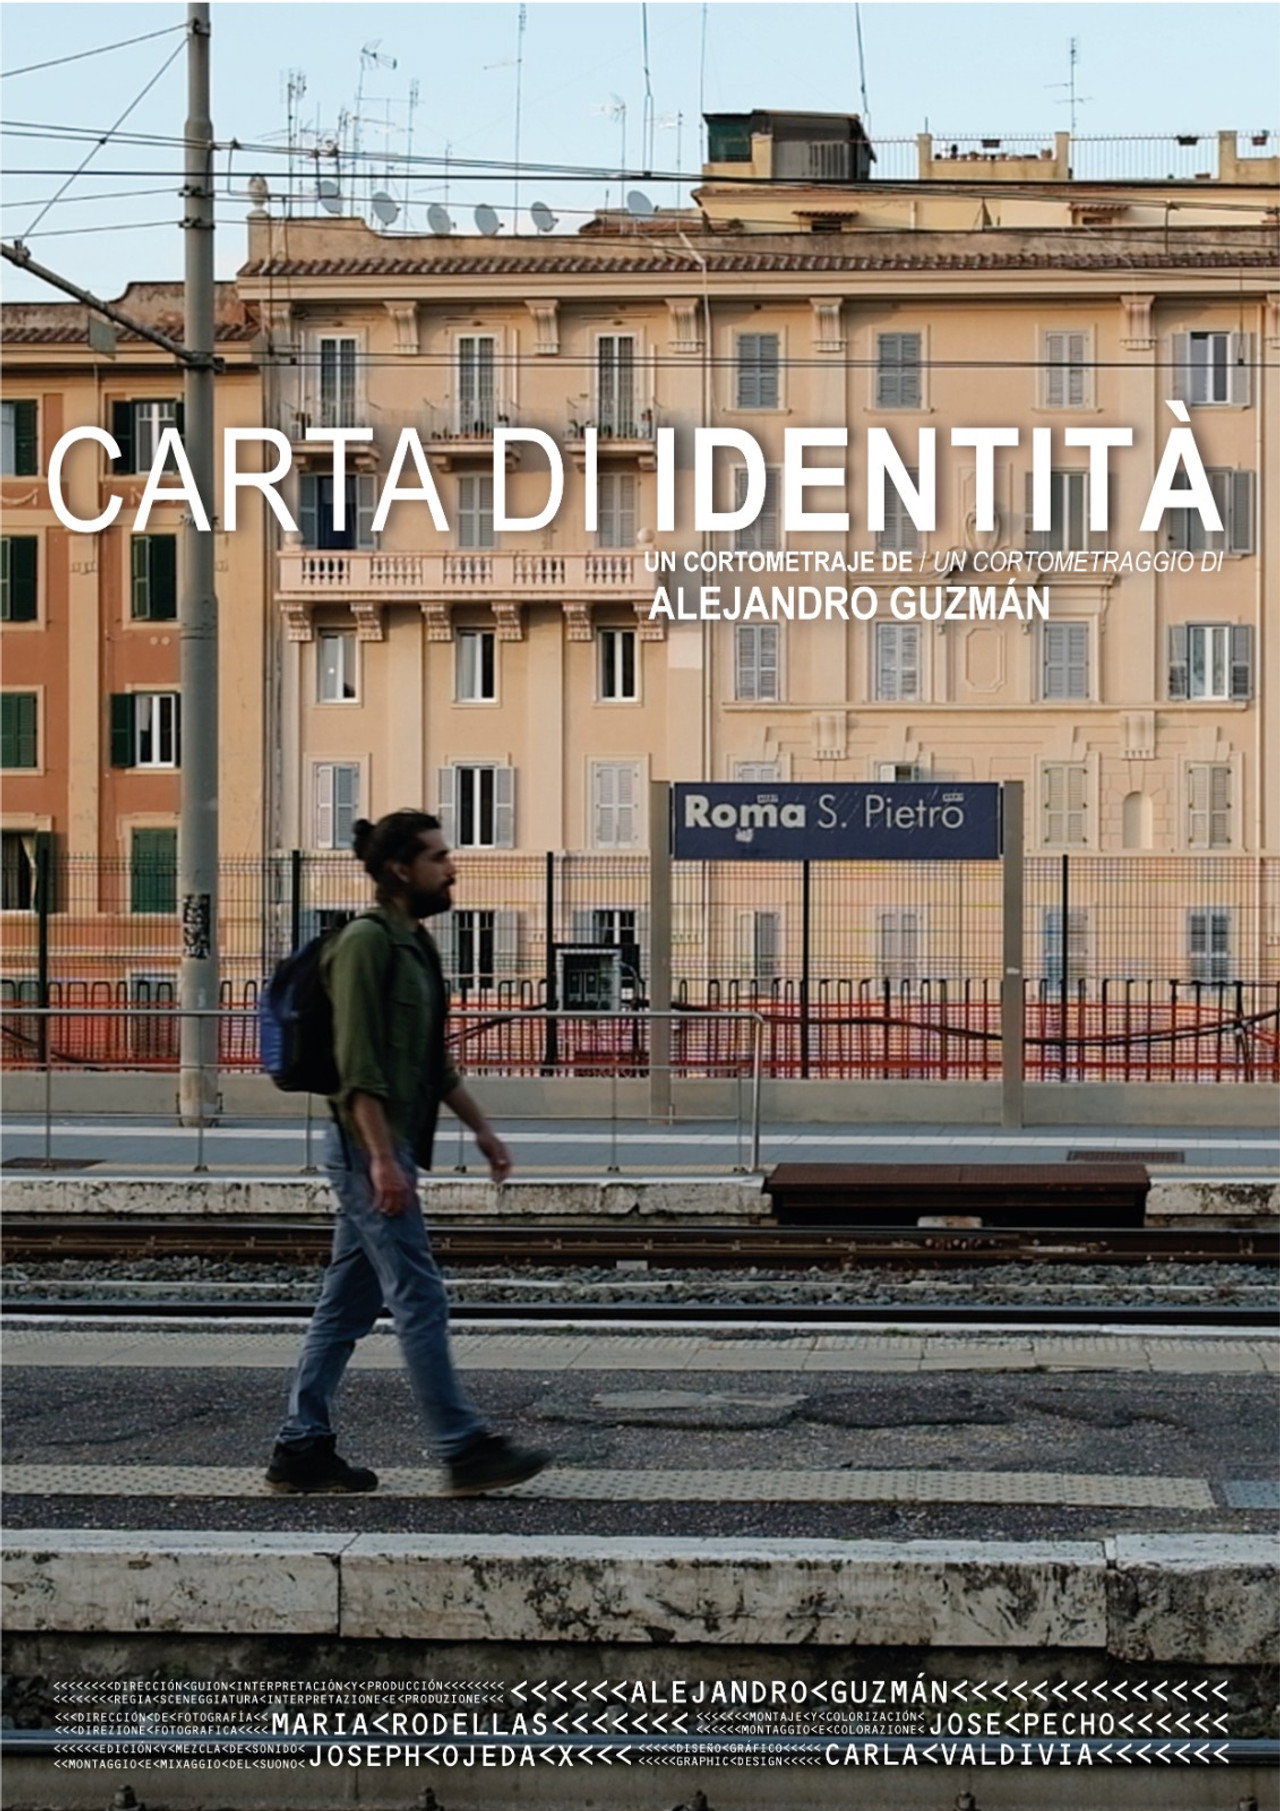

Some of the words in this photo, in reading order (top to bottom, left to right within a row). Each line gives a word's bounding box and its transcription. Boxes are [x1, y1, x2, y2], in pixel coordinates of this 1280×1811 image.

[685, 794, 806, 828] Roma
[818, 794, 848, 829] S.
[865, 794, 965, 829] Pietro
